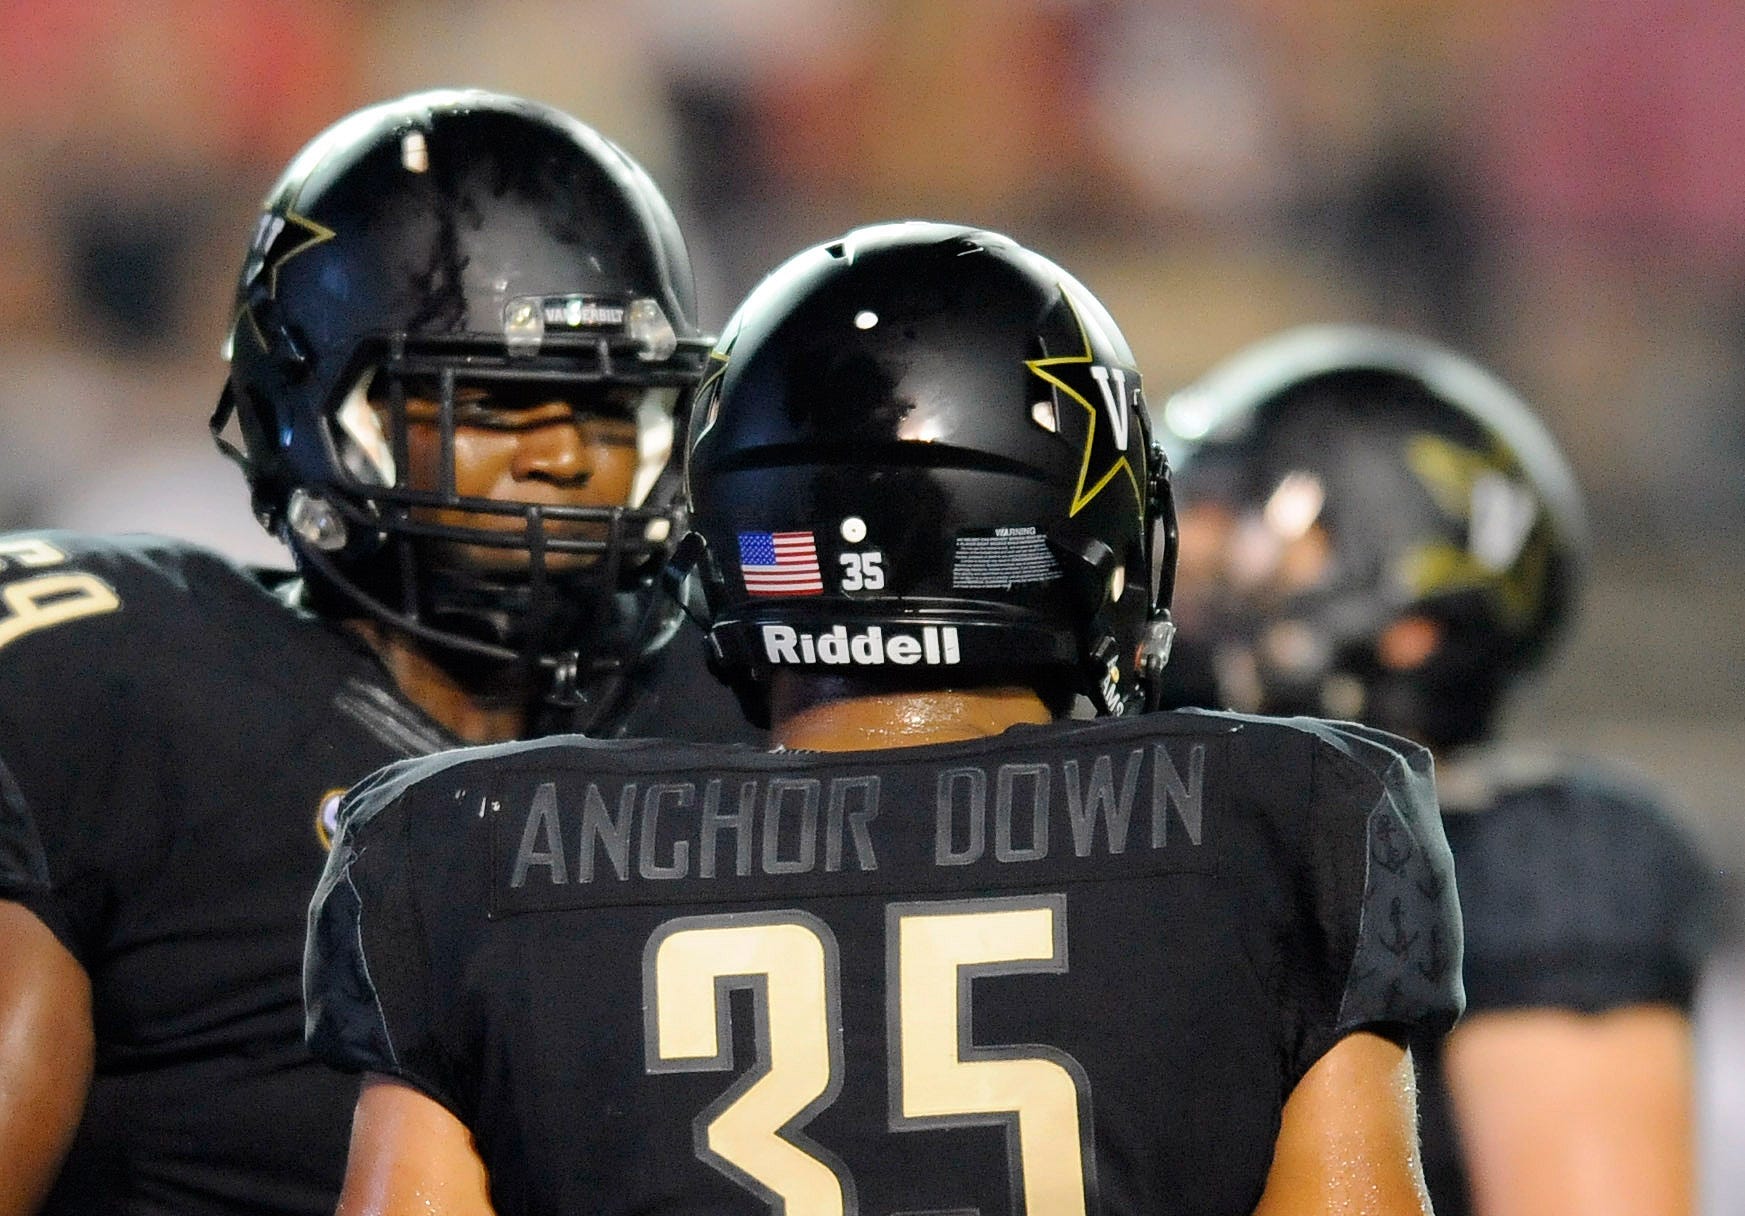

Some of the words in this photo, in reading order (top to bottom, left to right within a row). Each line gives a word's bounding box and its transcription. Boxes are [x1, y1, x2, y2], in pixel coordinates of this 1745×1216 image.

[545, 307, 624, 323] VAERBILT
[1090, 366, 1128, 450] V
[995, 526, 1036, 537] WARNING
[840, 552, 885, 591] 35
[762, 624, 961, 665] Riddell
[511, 775, 881, 887] ANCHOR
[934, 743, 1206, 866] DOWN
